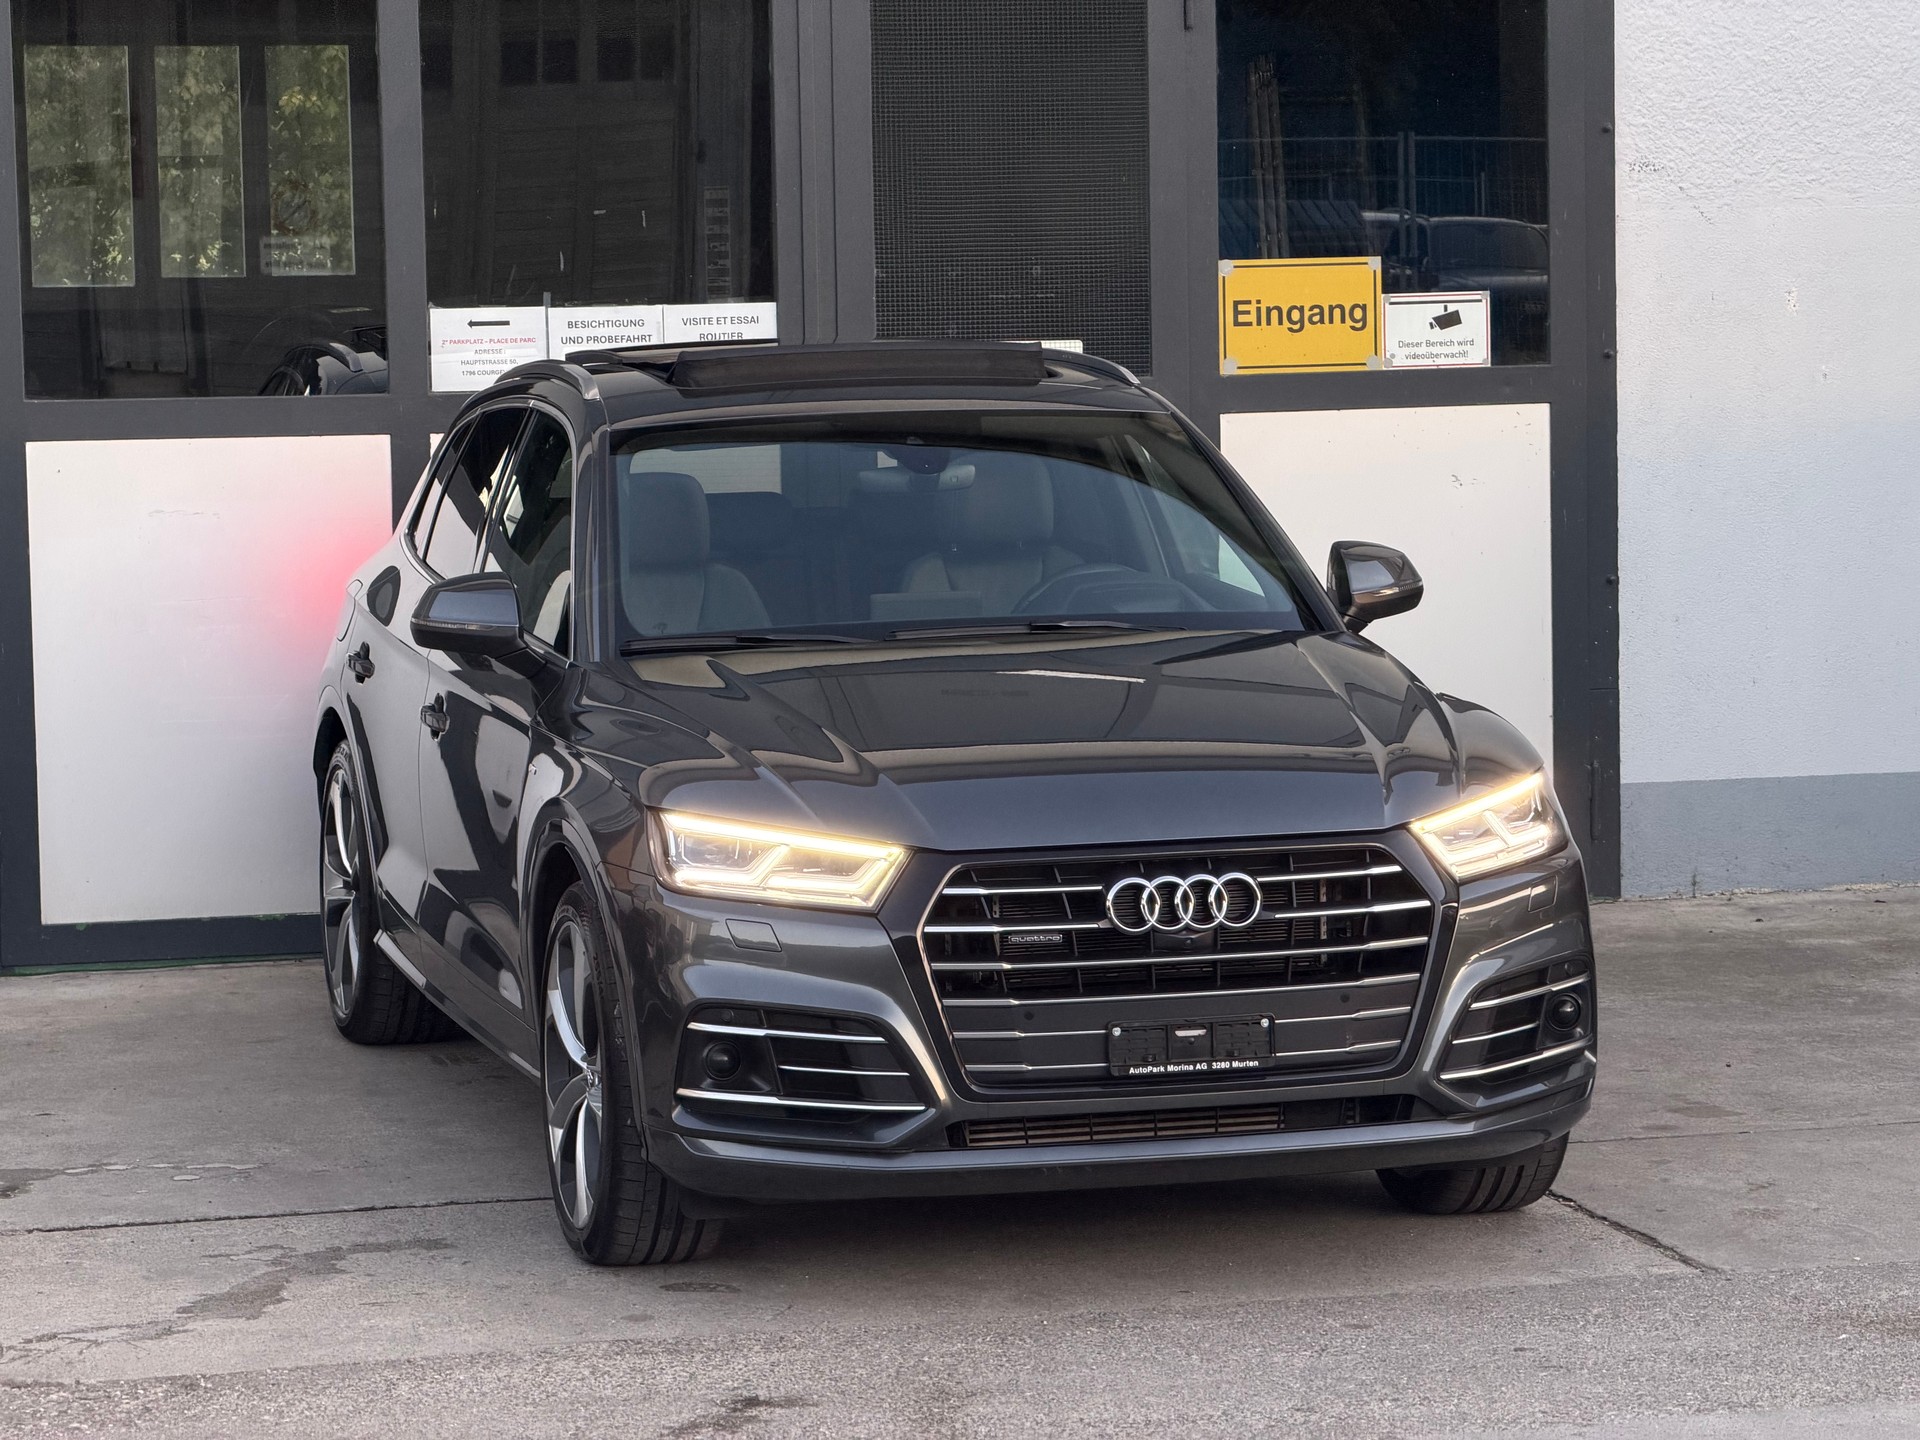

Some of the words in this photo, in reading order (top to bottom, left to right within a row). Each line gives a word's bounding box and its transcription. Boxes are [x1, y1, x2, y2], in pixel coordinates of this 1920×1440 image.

[682, 317, 714, 326] VISITE
[716, 317, 728, 325] ET
[730, 316, 759, 325] ESSAI
[1232, 299, 1368, 333] Eingang
[567, 319, 645, 329] BESICHTIGUNG
[561, 335, 583, 345] UND
[586, 334, 653, 345] PROBEFAHRT
[699, 332, 744, 342] ROUTIER
[1398, 340, 1423, 348] Dieser
[1425, 339, 1455, 348] Bereich
[1456, 338, 1475, 346] wird
[1404, 350, 1469, 360] videoüberwacht!
[1010, 935, 1061, 943] quattro
[1129, 1065, 1165, 1075] AutoPark
[1167, 1064, 1194, 1072] Morina
[1211, 1061, 1230, 1069] 3280
[1232, 1060, 1259, 1068] Murten
